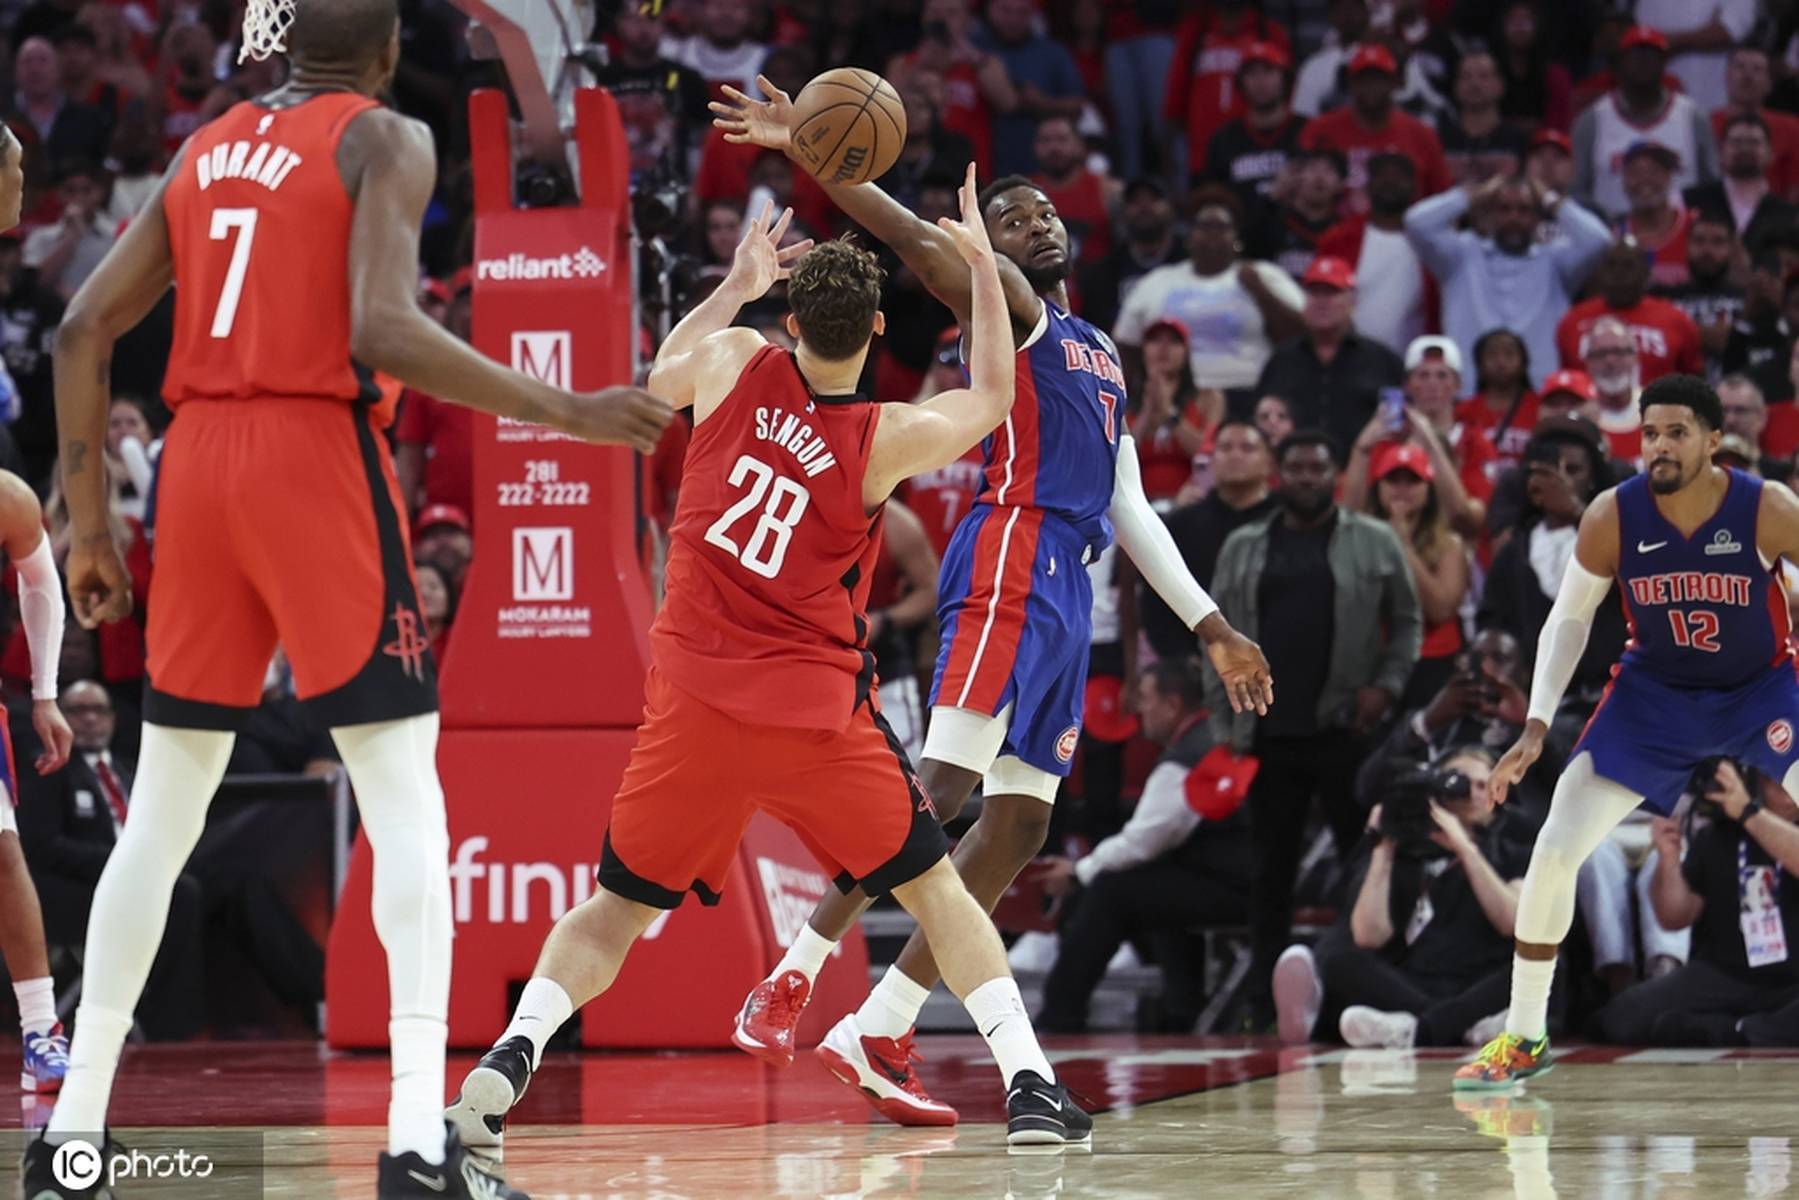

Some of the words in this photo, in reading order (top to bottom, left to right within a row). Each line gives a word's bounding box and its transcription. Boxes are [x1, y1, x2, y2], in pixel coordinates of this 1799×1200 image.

[196, 140, 302, 191] DURANT
[209, 208, 258, 338] 7
[478, 253, 573, 279] reliant
[755, 407, 836, 478] SENGUN
[1098, 389, 1117, 445] 7
[704, 454, 810, 579] 28
[1629, 571, 1751, 606] DETROIT
[1668, 610, 1721, 652] 12
